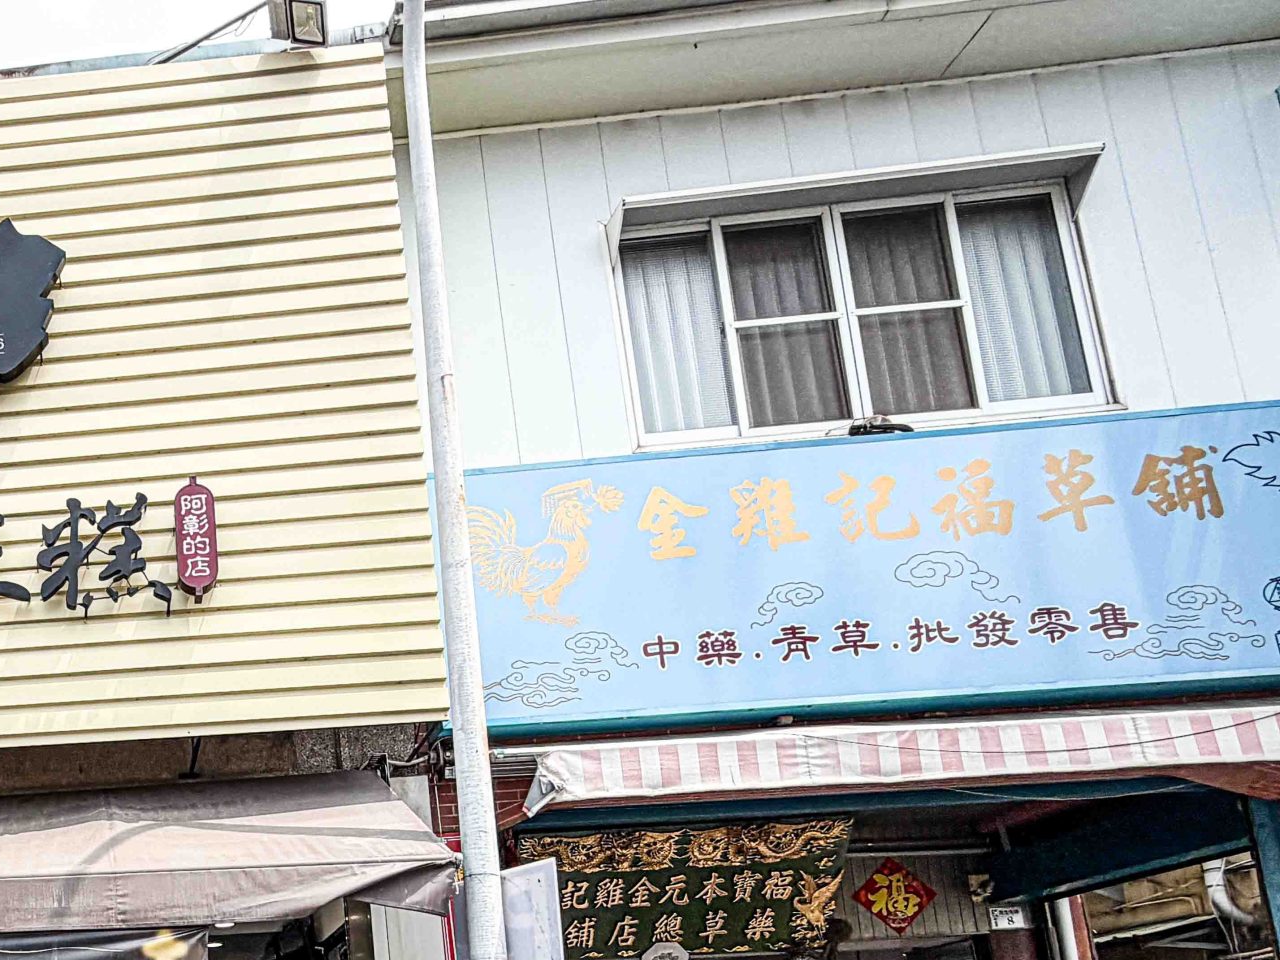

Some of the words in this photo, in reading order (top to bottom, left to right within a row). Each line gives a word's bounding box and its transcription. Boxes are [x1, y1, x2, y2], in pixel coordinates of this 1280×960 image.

[179, 493, 211, 578] 阿彰的店
[868, 873, 921, 917] 福
[1007, 915, 1015, 926] 8
